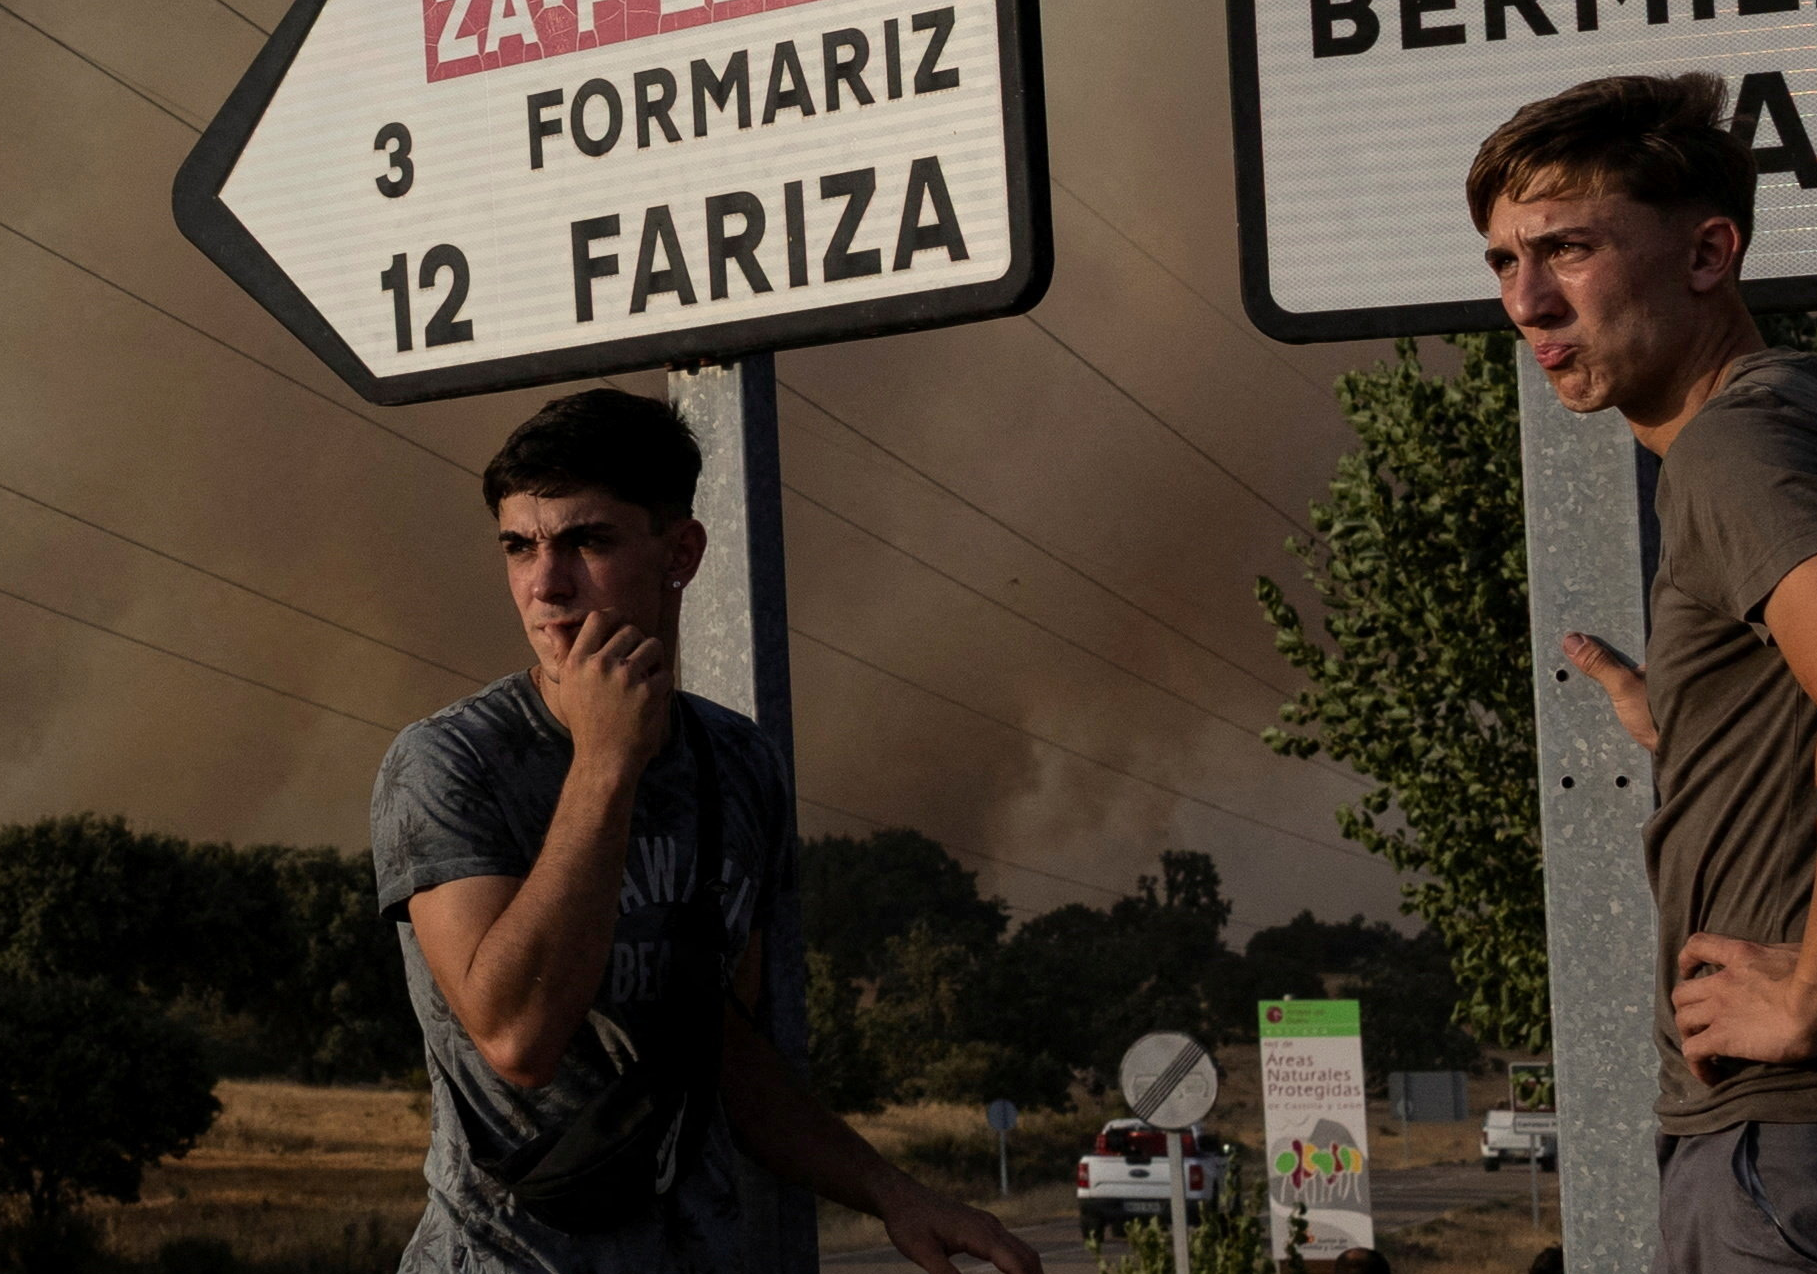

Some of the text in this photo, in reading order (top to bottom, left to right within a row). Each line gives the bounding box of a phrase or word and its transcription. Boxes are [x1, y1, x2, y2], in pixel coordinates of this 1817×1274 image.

[373, 6, 961, 199] 3 FORMARIZ
[380, 155, 971, 353] 12 FARIZA
[1266, 1048, 1314, 1067] Áreas
[1267, 1068, 1352, 1082] Naturales
[1268, 1083, 1362, 1101] Protegidas
